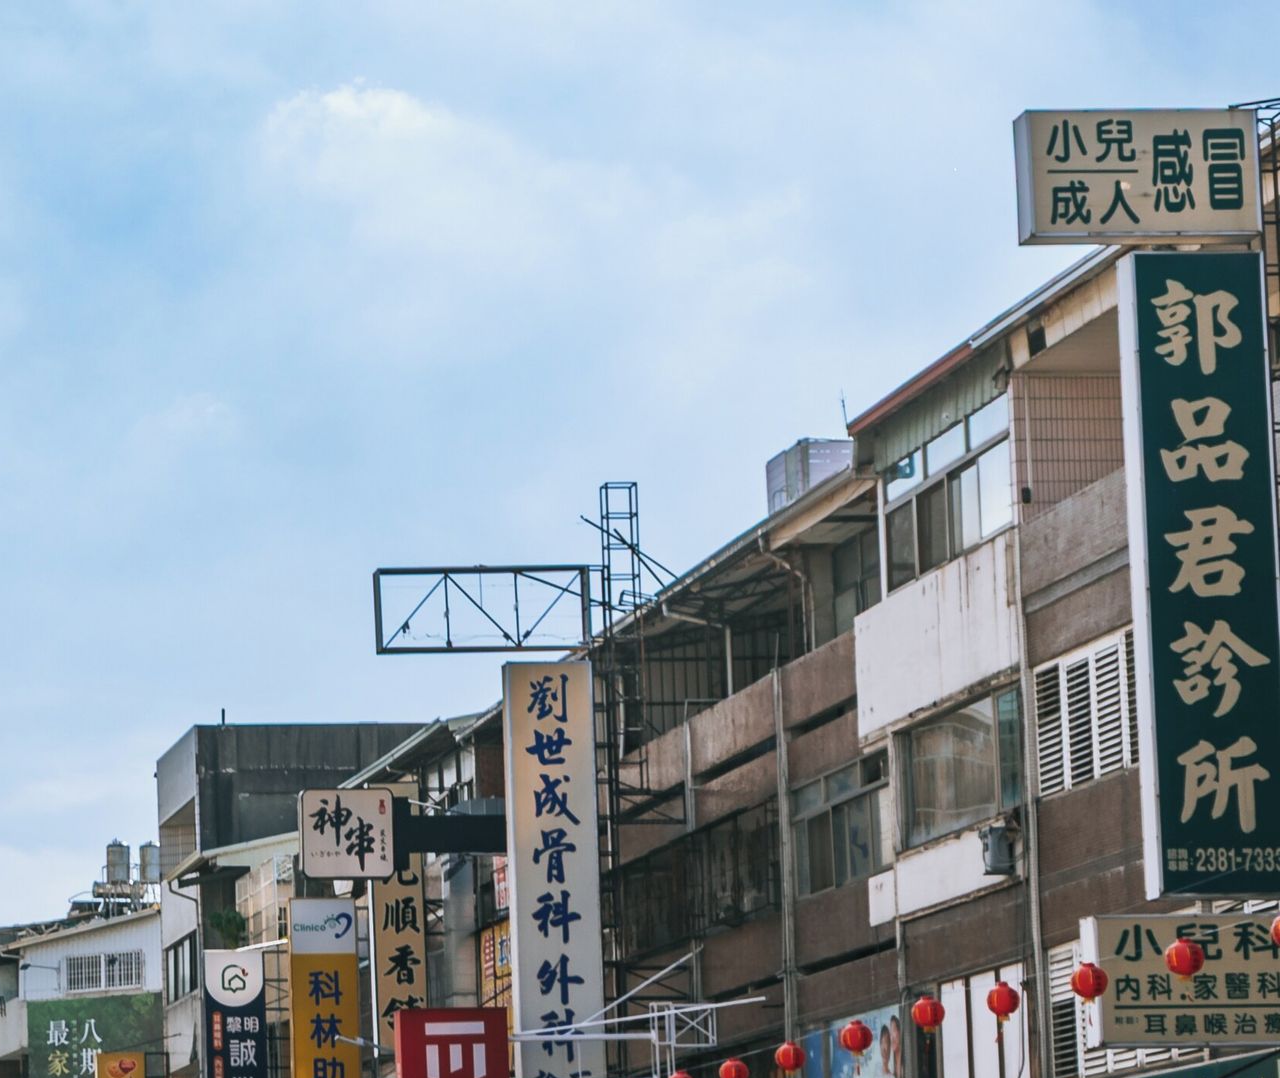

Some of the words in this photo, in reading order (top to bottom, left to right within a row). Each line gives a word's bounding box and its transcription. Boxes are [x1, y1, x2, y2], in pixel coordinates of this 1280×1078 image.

[1046, 118, 1137, 163] 小兒
[1152, 128, 1246, 213] 感冒
[1051, 180, 1140, 225] 成人
[1151, 279, 1271, 833] 郭品君診所
[293, 922, 327, 933] Clinico
[226, 1016, 260, 1033] 黎明
